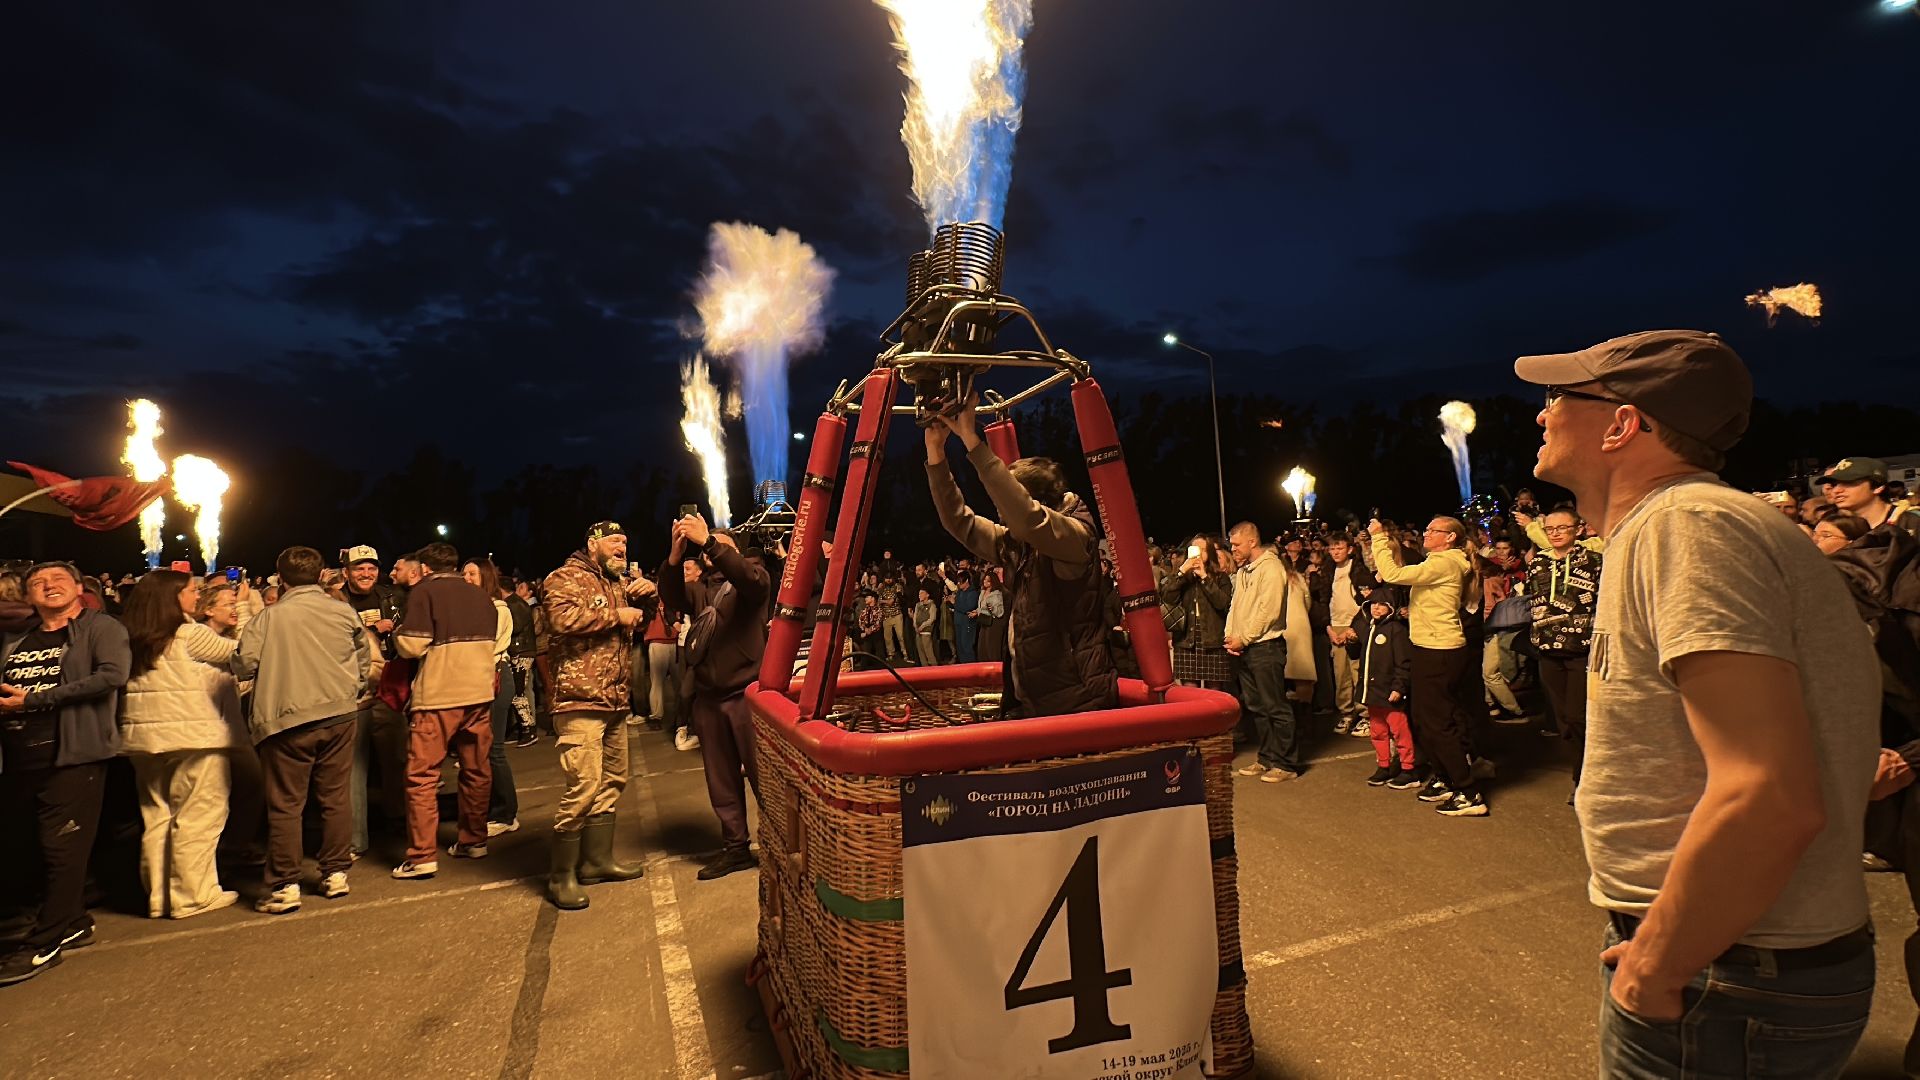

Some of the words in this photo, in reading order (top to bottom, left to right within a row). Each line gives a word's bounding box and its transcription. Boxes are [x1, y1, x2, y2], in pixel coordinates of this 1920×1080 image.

[967, 790, 1045, 802] Фестиваль
[1048, 770, 1147, 798] воздухоплавания
[988, 803, 1048, 818] «ГОРОД
[1052, 800, 1071, 814] НА
[1073, 787, 1131, 810] ЛАДОНИ»
[1004, 835, 1132, 1054] 4
[1101, 1055, 1136, 1071] 14-19
[1140, 1053, 1165, 1066] мая
[1135, 1066, 1173, 1080] округ
